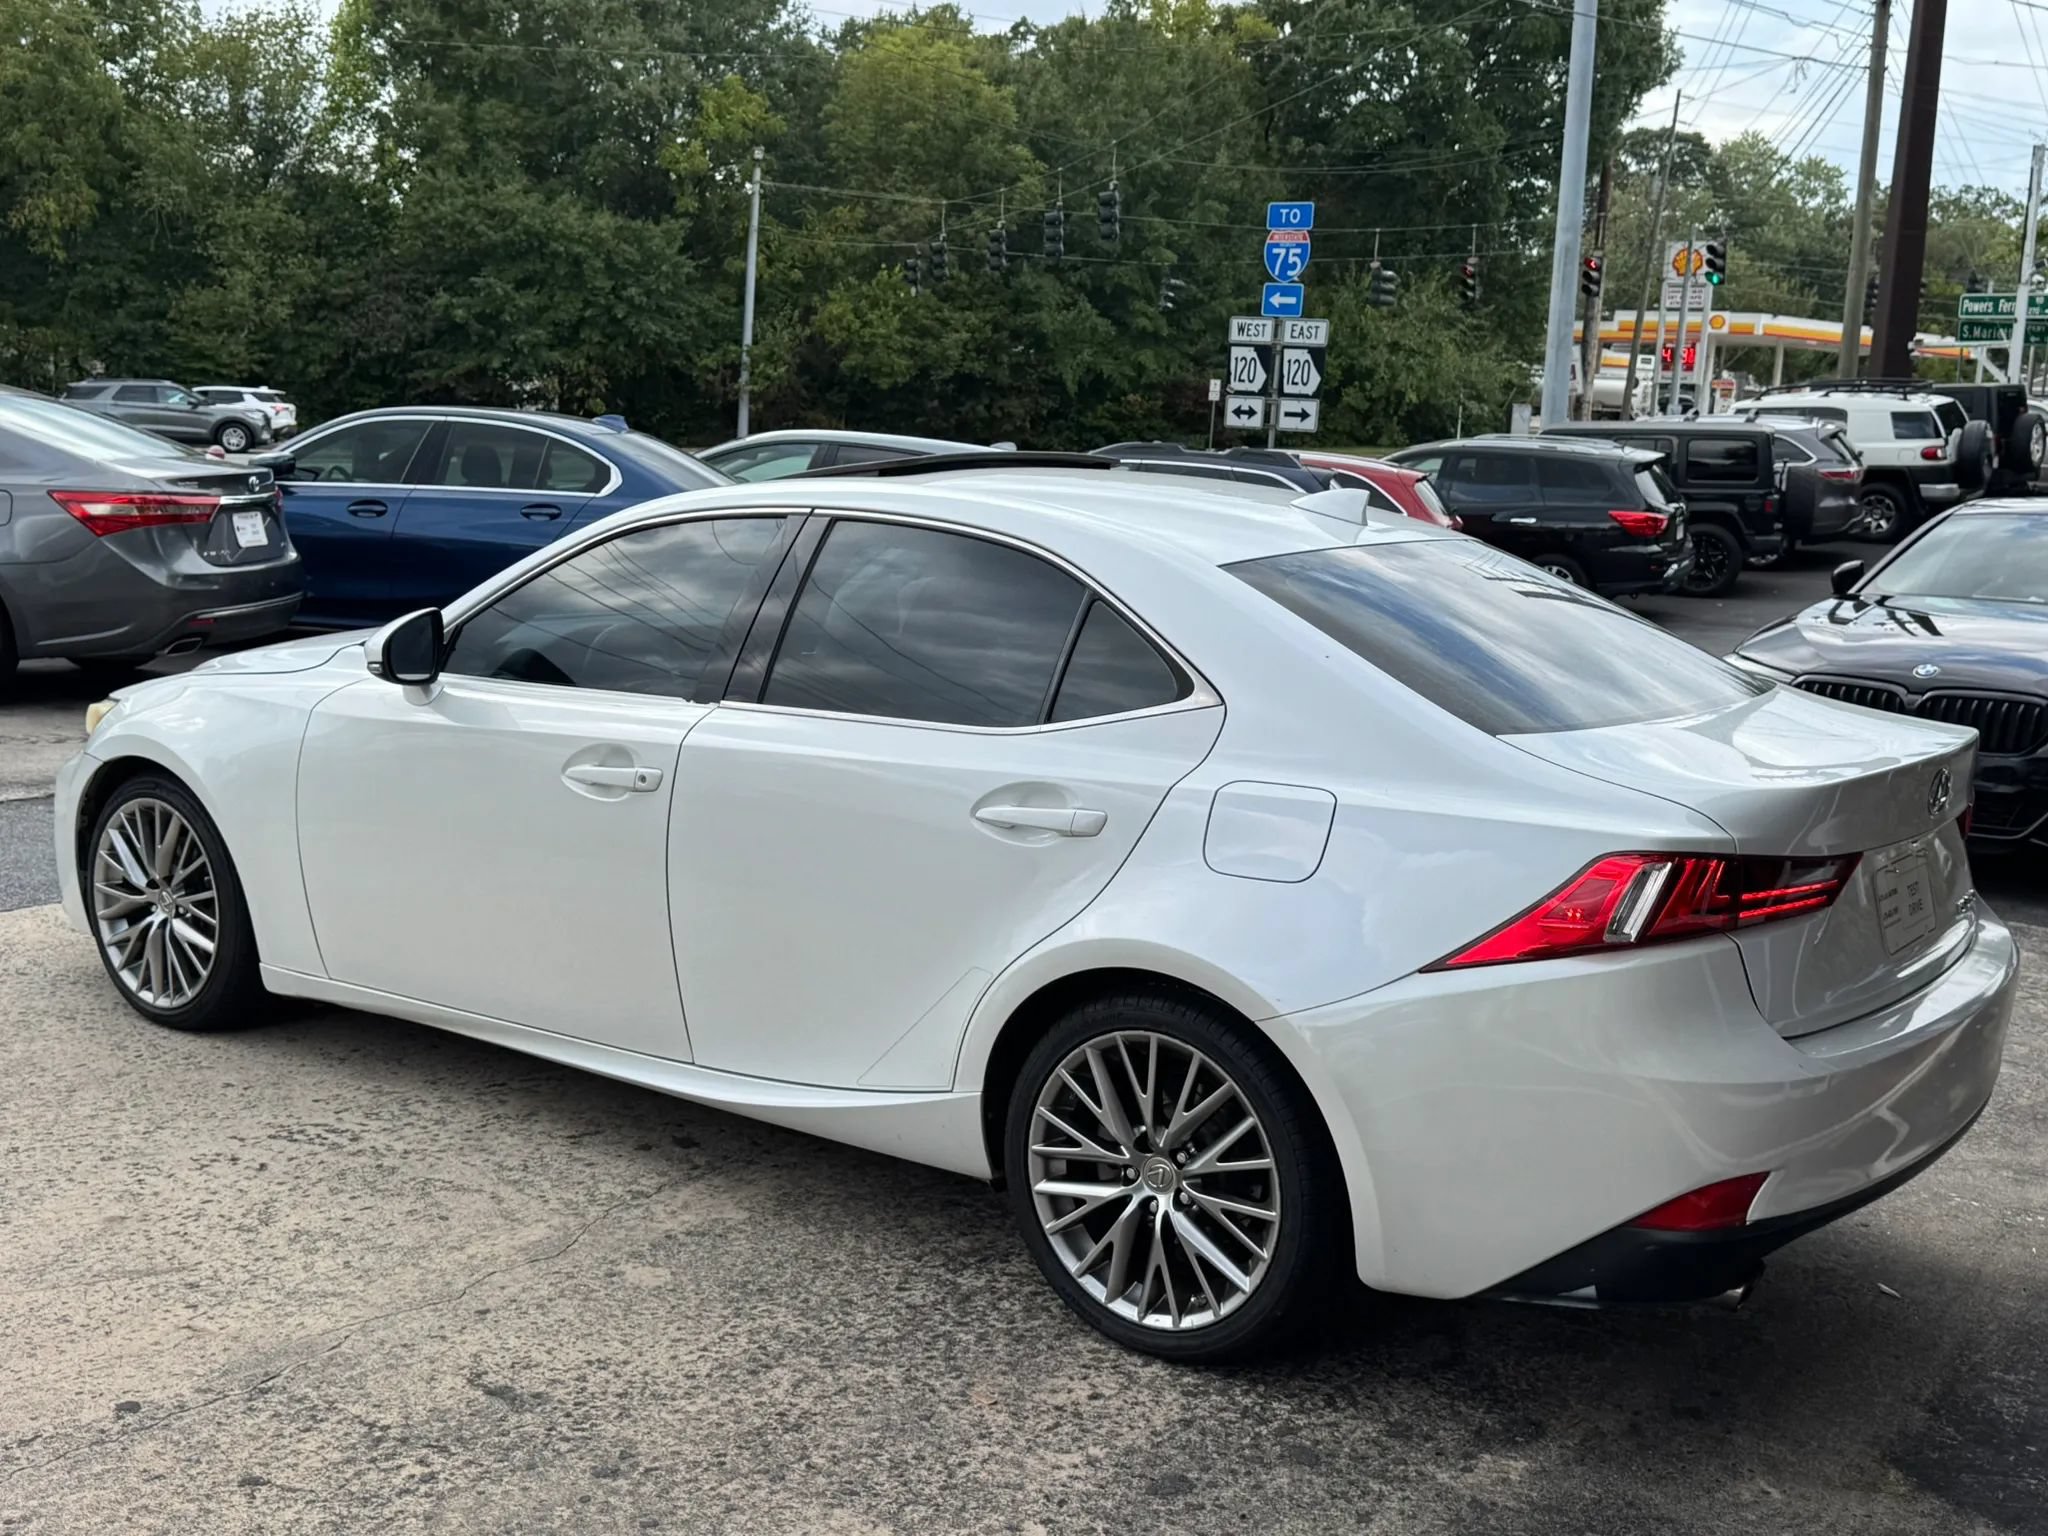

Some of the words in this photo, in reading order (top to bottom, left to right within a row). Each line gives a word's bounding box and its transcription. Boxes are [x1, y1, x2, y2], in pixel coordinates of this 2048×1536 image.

[1279, 208, 1301, 224] TO
[1272, 247, 1302, 277] 75
[1963, 299, 1993, 314] Powers
[1998, 299, 2017, 314] Ferr
[1236, 321, 1267, 338] WEST
[1289, 323, 1320, 340] EAST
[1233, 356, 1258, 384] 120
[1286, 358, 1311, 387] 120
